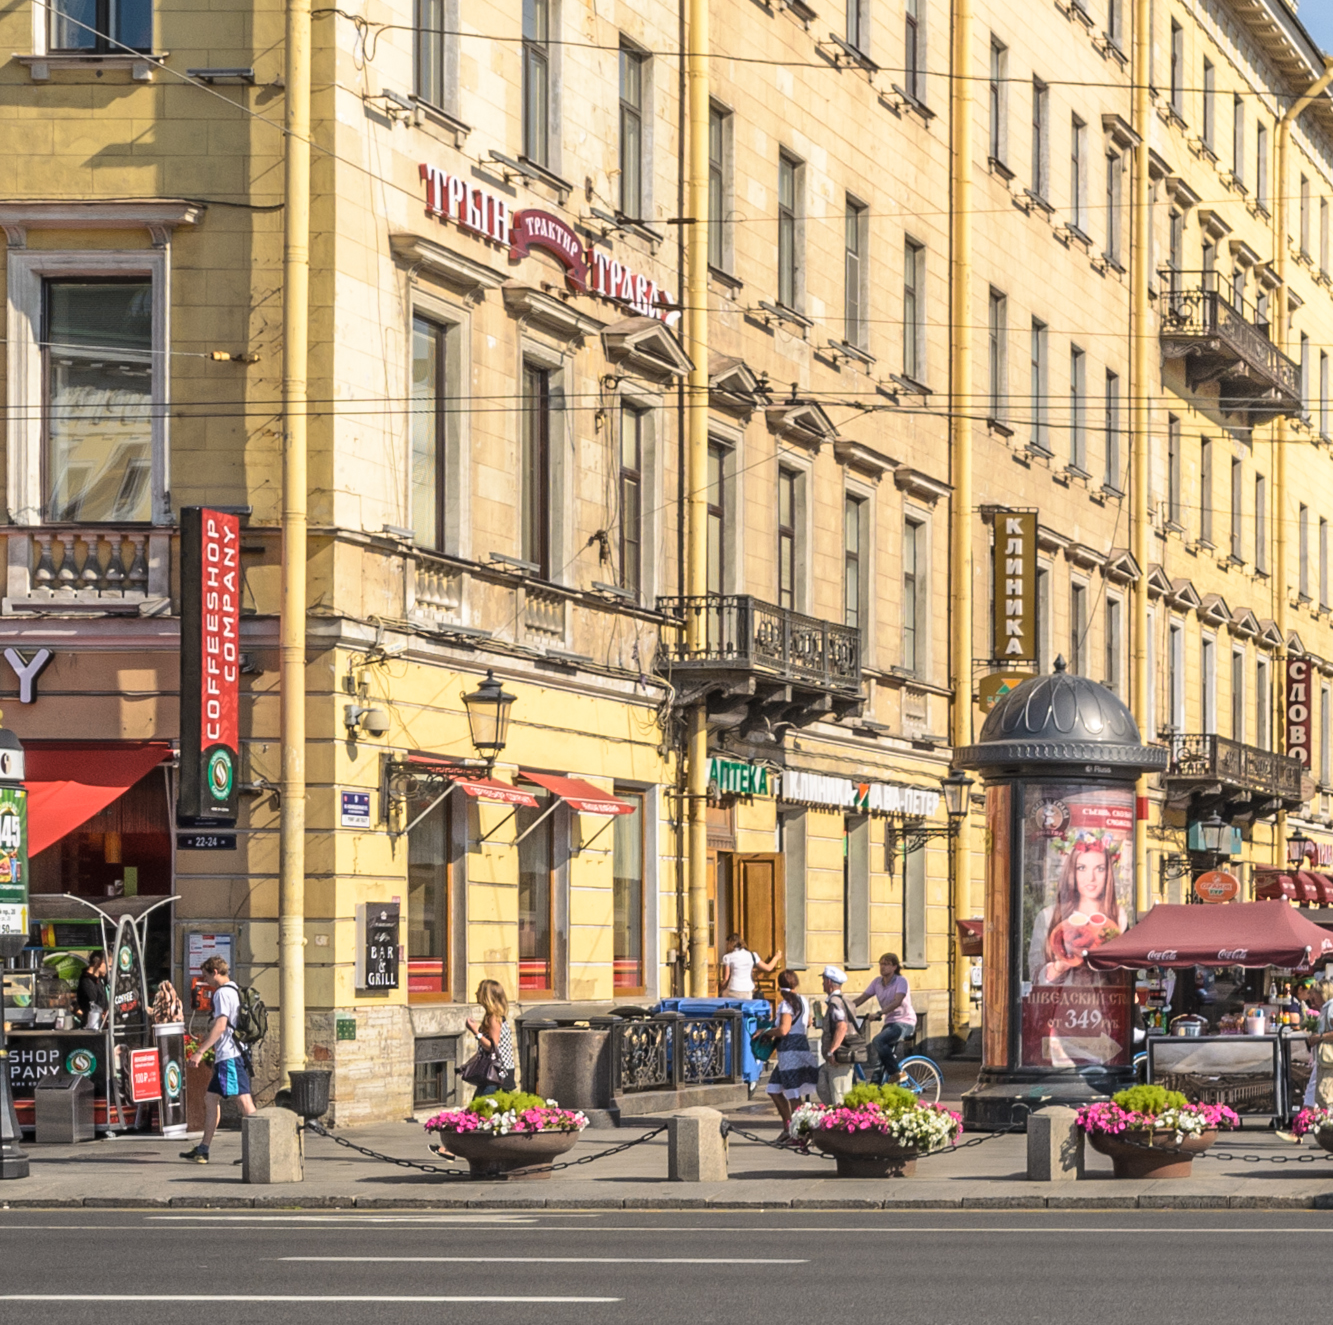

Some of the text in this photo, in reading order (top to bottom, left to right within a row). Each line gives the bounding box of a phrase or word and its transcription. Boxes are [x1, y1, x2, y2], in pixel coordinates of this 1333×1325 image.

[419, 163, 510, 246] ТРЫН
[525, 217, 579, 257] ТРАКТИР
[588, 248, 668, 321] ТРАВА
[223, 525, 236, 683] COMPANY
[1005, 517, 1024, 654] КЛИНИКА
[207, 518, 220, 741] COFFEESHOP
[1288, 661, 1308, 766] СЛОВО
[708, 757, 768, 795] АПТЕКА
[787, 770, 940, 816] КЛИНИКА АВА-ПЕТЕР
[195, 836, 218, 847] 22-24
[370, 946, 394, 959] BAR
[368, 972, 396, 986] GRILL
[1027, 990, 1105, 1006] ШВЕДСКИЙ
[1064, 1008, 1102, 1029] 349
[9, 1049, 60, 1063] SHOP
[10, 1065, 60, 1079] PANY
